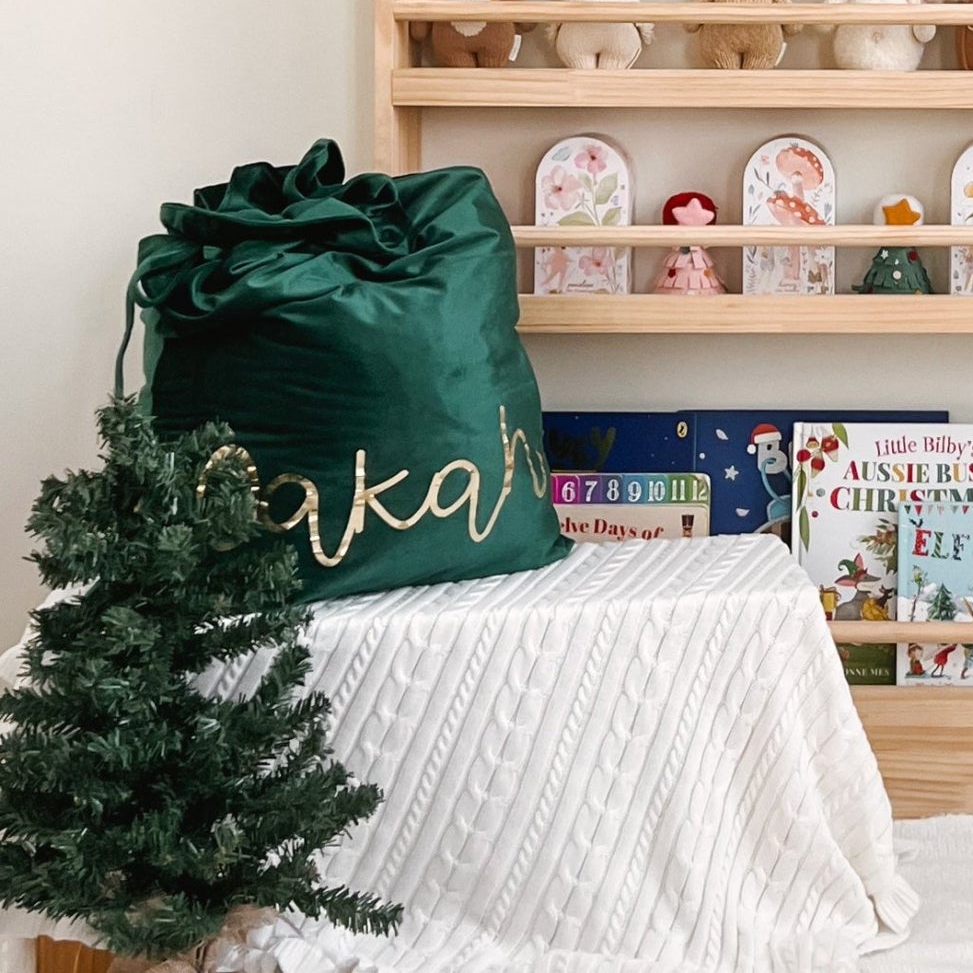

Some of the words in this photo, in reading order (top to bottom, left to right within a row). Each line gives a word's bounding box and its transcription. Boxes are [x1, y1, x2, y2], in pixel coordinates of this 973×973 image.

[874, 434, 917, 458] Little
[843, 459, 930, 484] AUSSIE
[561, 481, 576, 503] 6
[585, 480, 598, 502] 7
[606, 479, 620, 502] 8
[627, 481, 643, 503] 9
[647, 480, 666, 502] 10
[671, 479, 686, 502] 11
[691, 479, 708, 501] 12
[561, 517, 590, 533] lve
[594, 518, 637, 541] Days
[641, 526, 664, 541] of
[911, 528, 970, 562] ELF
